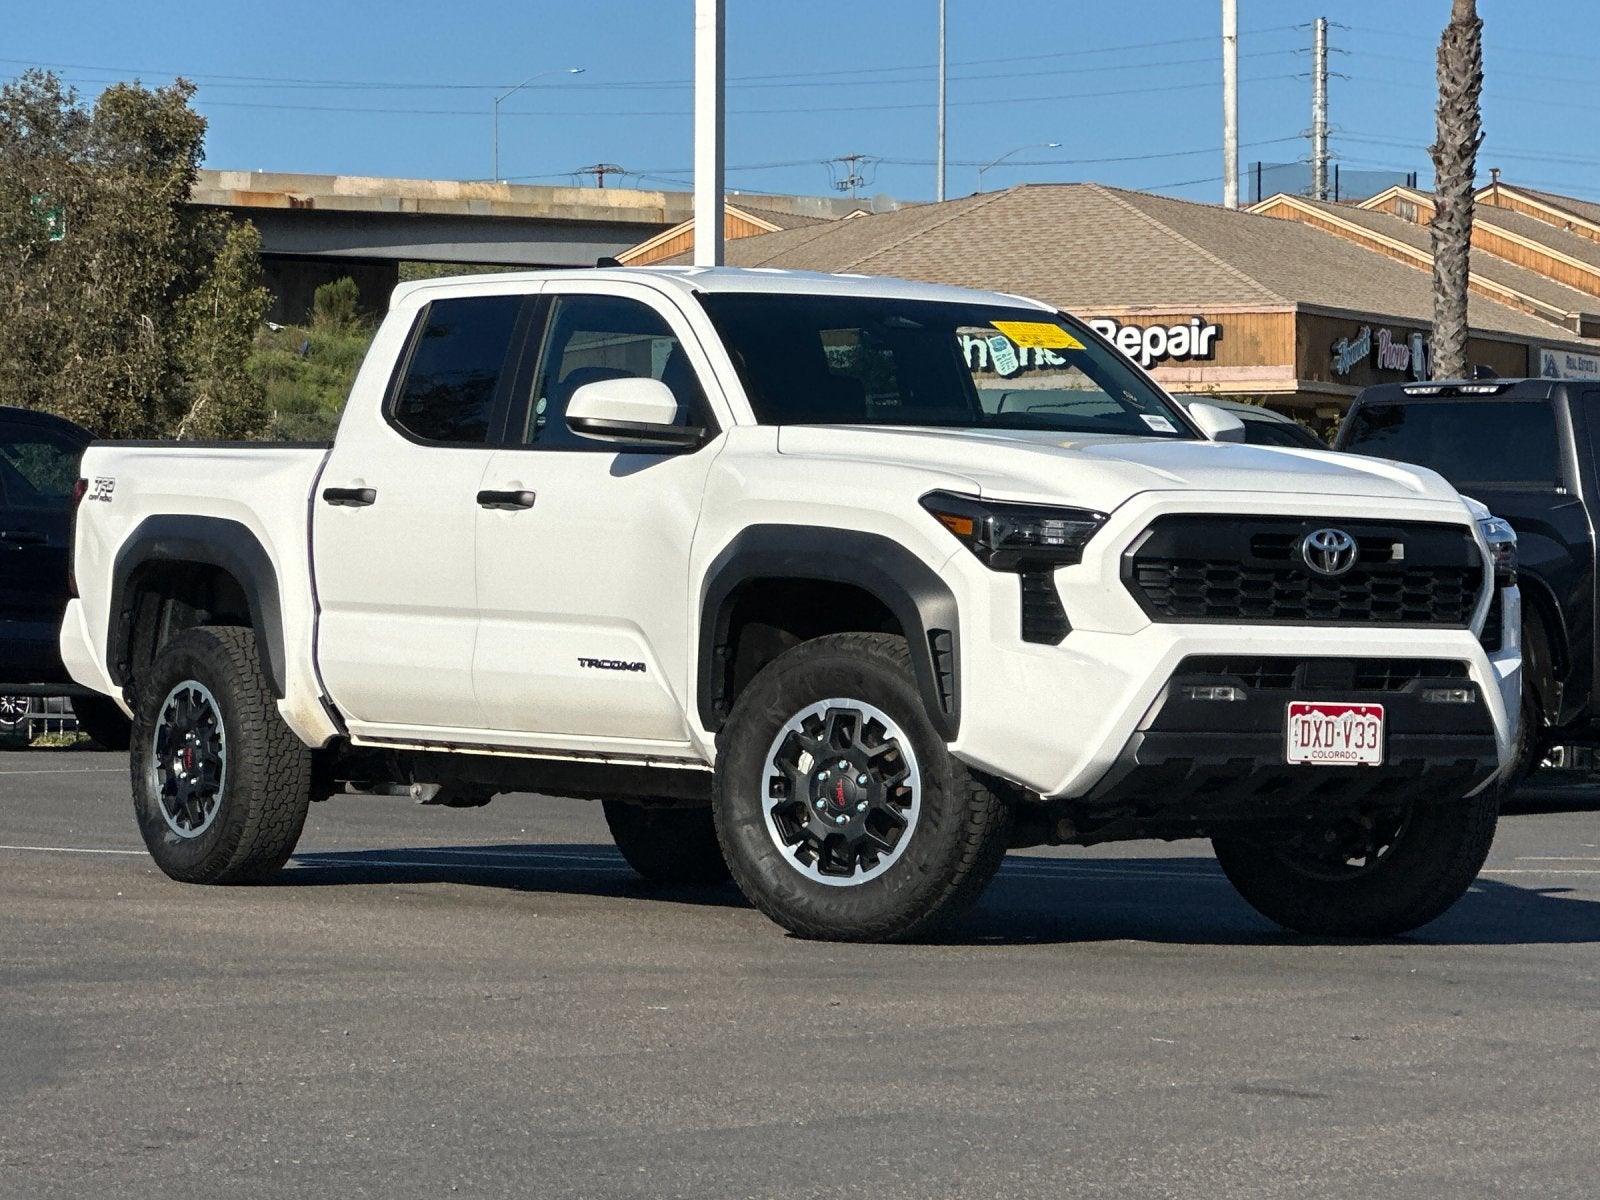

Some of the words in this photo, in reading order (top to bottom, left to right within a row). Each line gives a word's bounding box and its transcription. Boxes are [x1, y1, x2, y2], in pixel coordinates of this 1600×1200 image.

[1088, 318, 1216, 366] Repair
[577, 657, 647, 673] TACOMA
[1311, 750, 1358, 759] COLORADO
